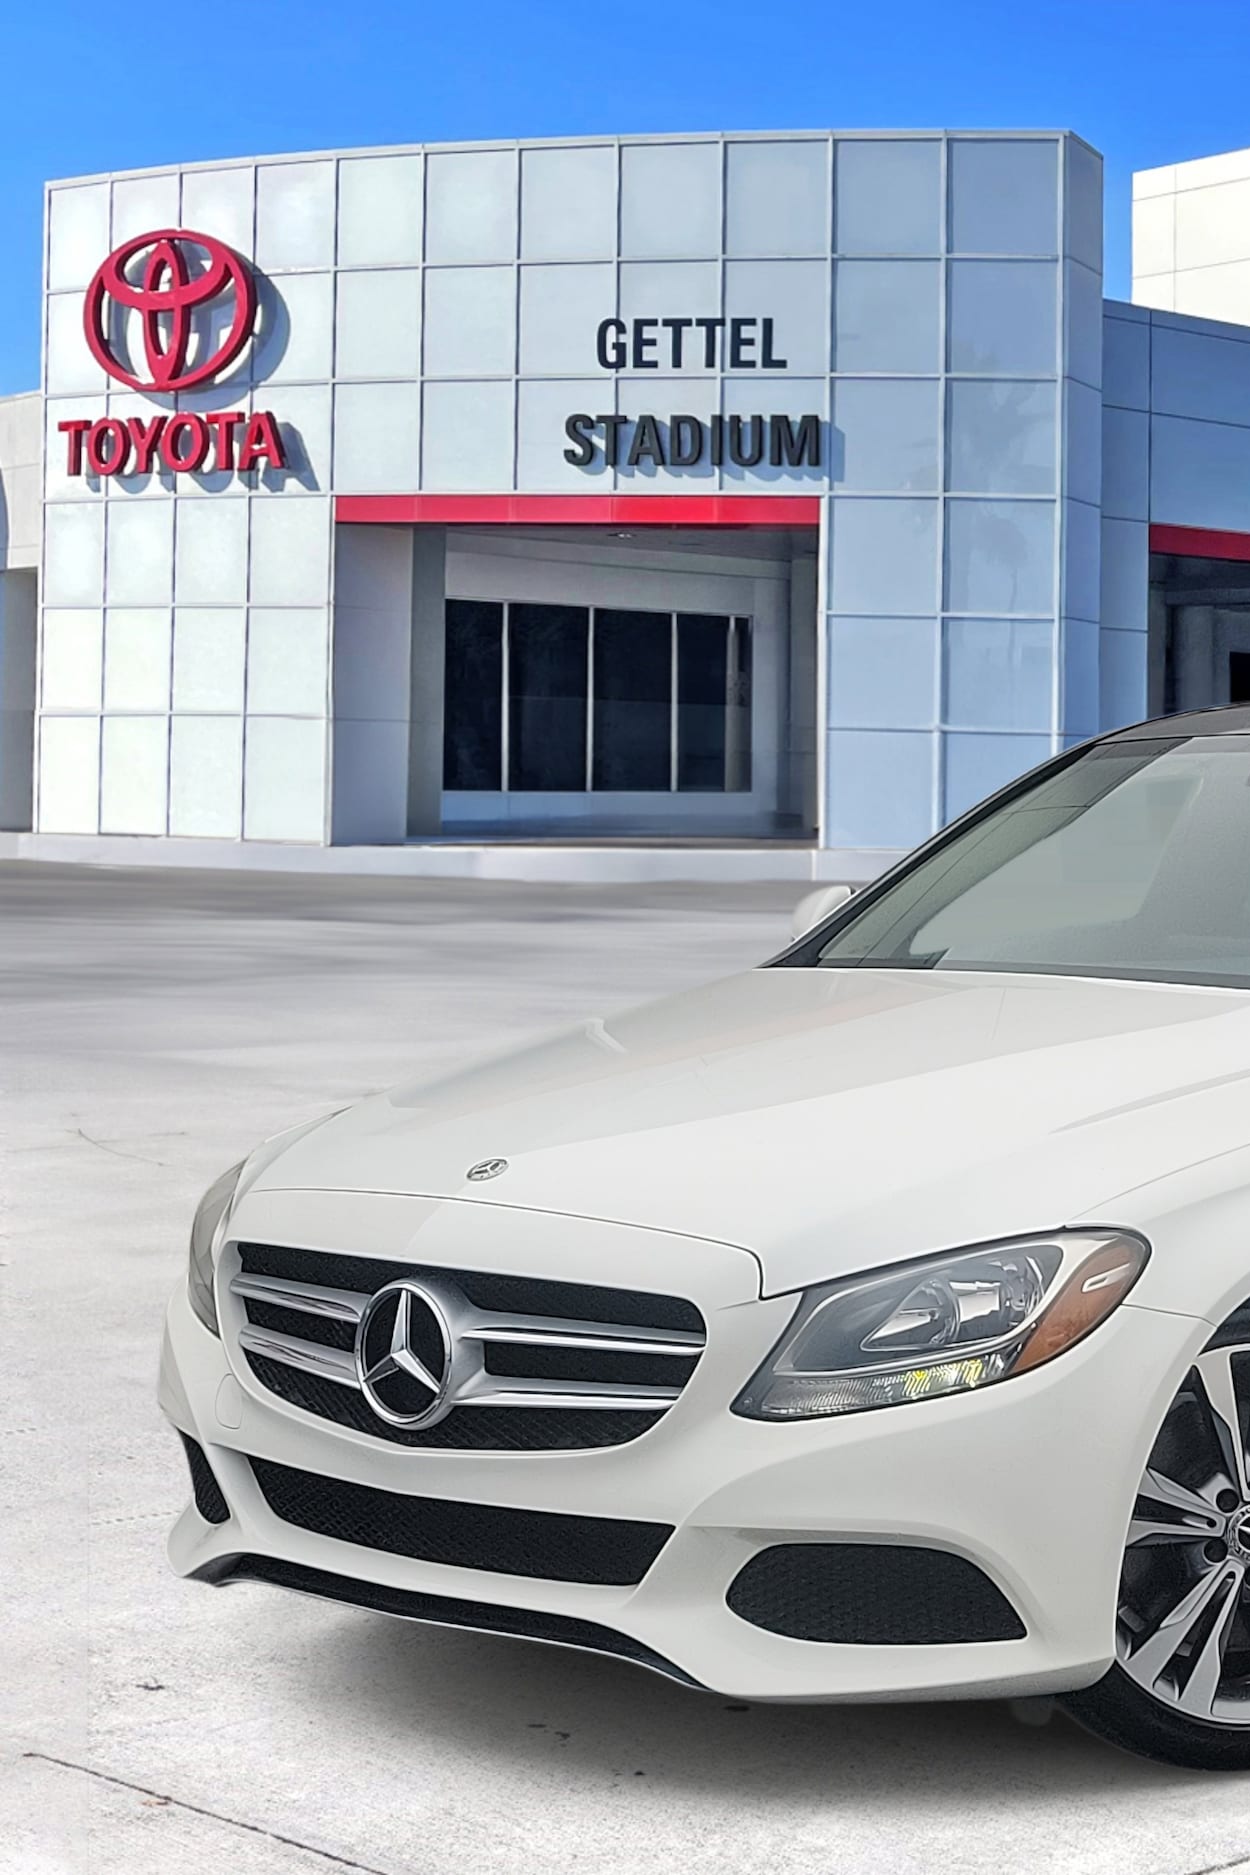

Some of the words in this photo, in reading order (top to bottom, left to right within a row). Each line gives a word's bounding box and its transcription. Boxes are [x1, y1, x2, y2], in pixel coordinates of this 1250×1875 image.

[597, 317, 788, 369] GETTEL
[58, 411, 286, 476] TOYOTA
[564, 413, 821, 467] STADIUM
